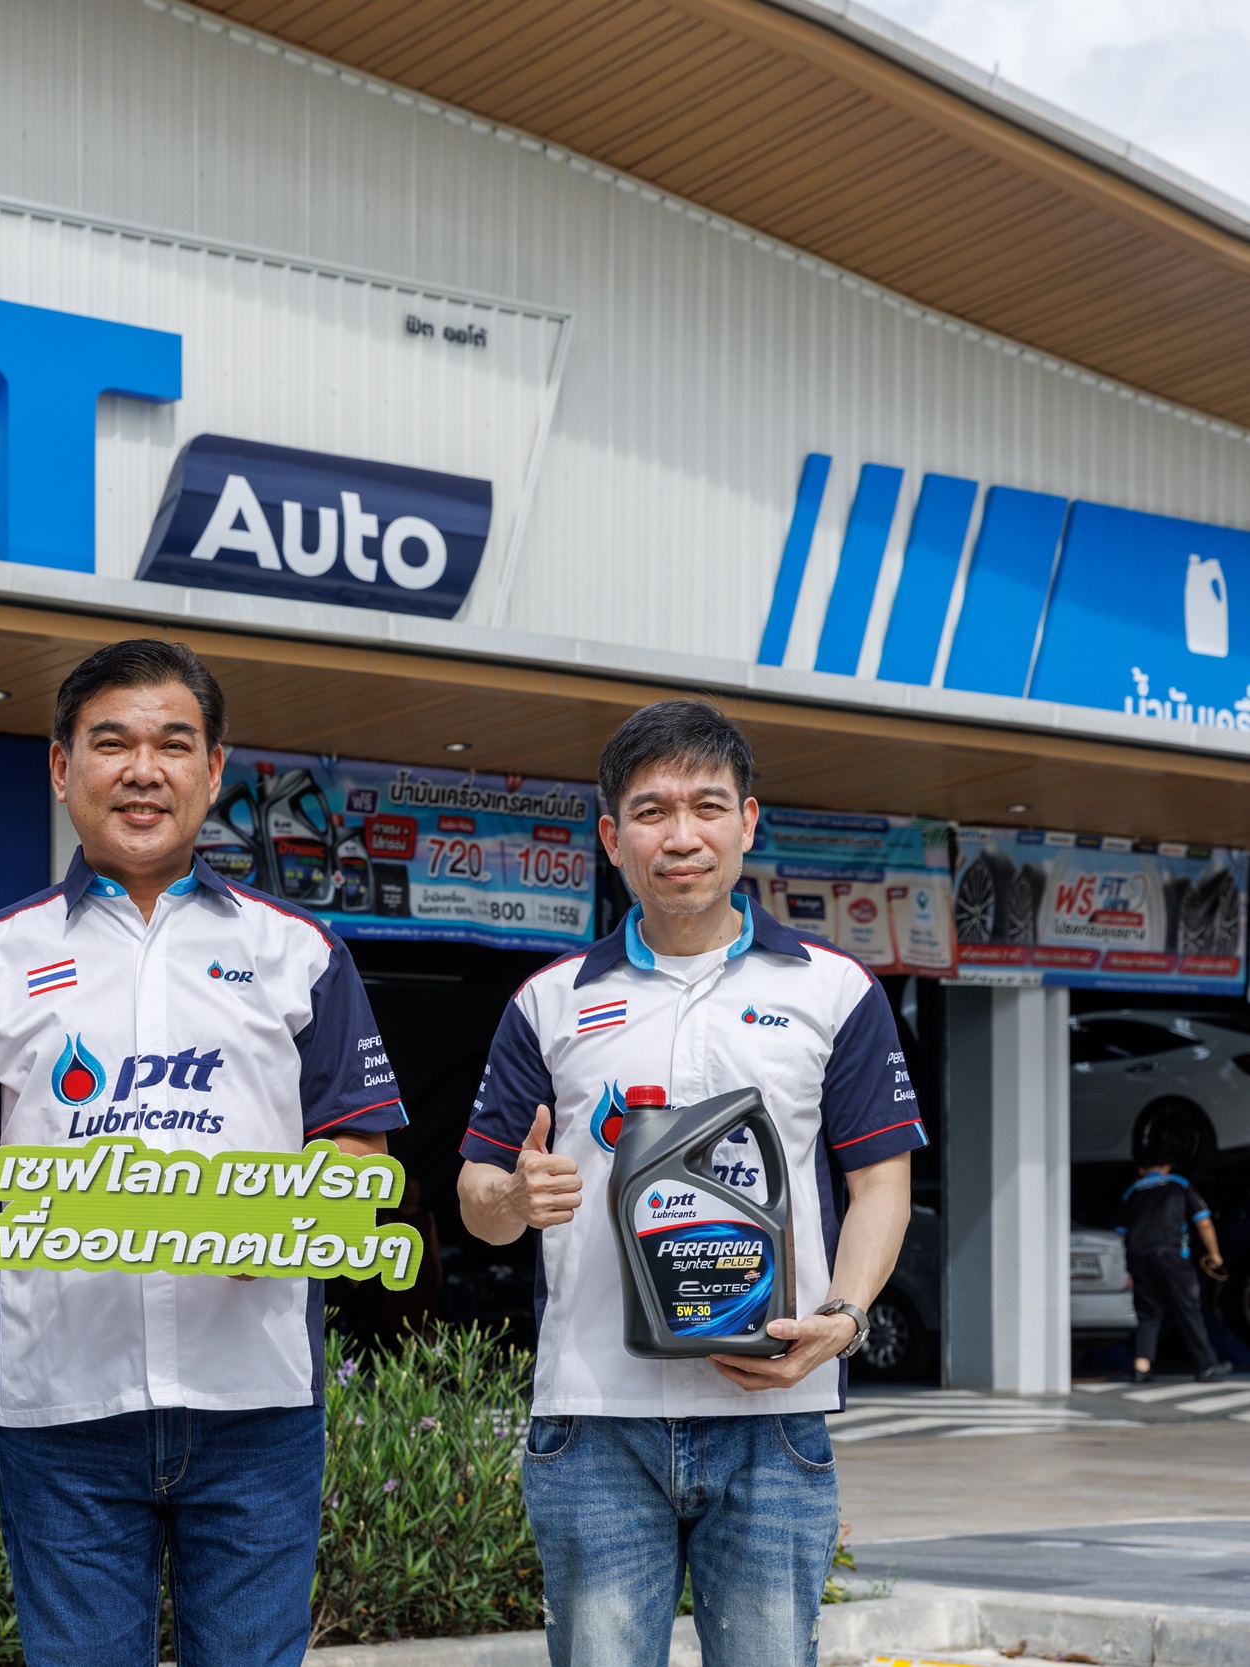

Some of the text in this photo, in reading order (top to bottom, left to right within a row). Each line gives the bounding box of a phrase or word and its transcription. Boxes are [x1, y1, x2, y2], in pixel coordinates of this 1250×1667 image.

[190, 474, 448, 590] Auto
[224, 970, 254, 984] OR
[757, 1014, 790, 1028] OR
[111, 1047, 225, 1102] ptt
[68, 1104, 226, 1140] Lubricants
[216, 1150, 395, 1200] เซฟรถ
[665, 1192, 696, 1209] ptt
[652, 1210, 697, 1219] Lubricants
[657, 1240, 763, 1257] PERFORMA
[671, 1257, 754, 1272] syntec PLUS
[676, 1305, 711, 1317] 5W-30
